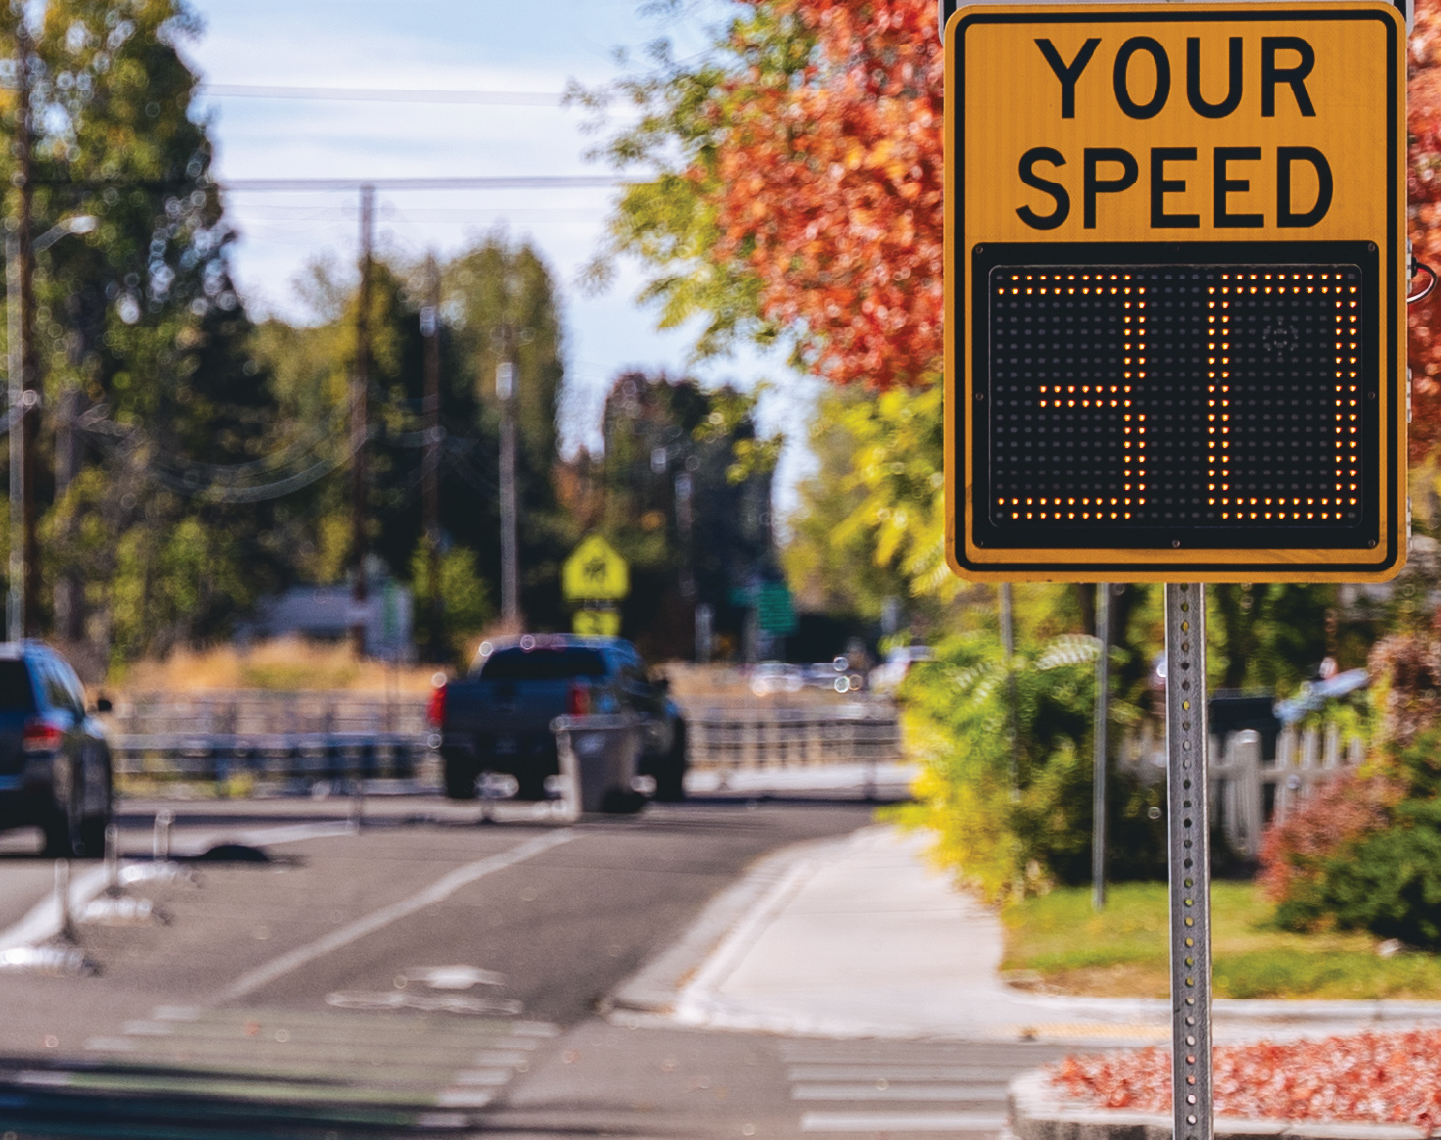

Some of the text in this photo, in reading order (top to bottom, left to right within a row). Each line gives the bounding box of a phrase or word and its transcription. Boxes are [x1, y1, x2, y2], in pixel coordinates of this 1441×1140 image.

[1034, 36, 1317, 119] YOUR
[1014, 146, 1334, 230] SPEED
[997, 274, 1357, 520] 30
